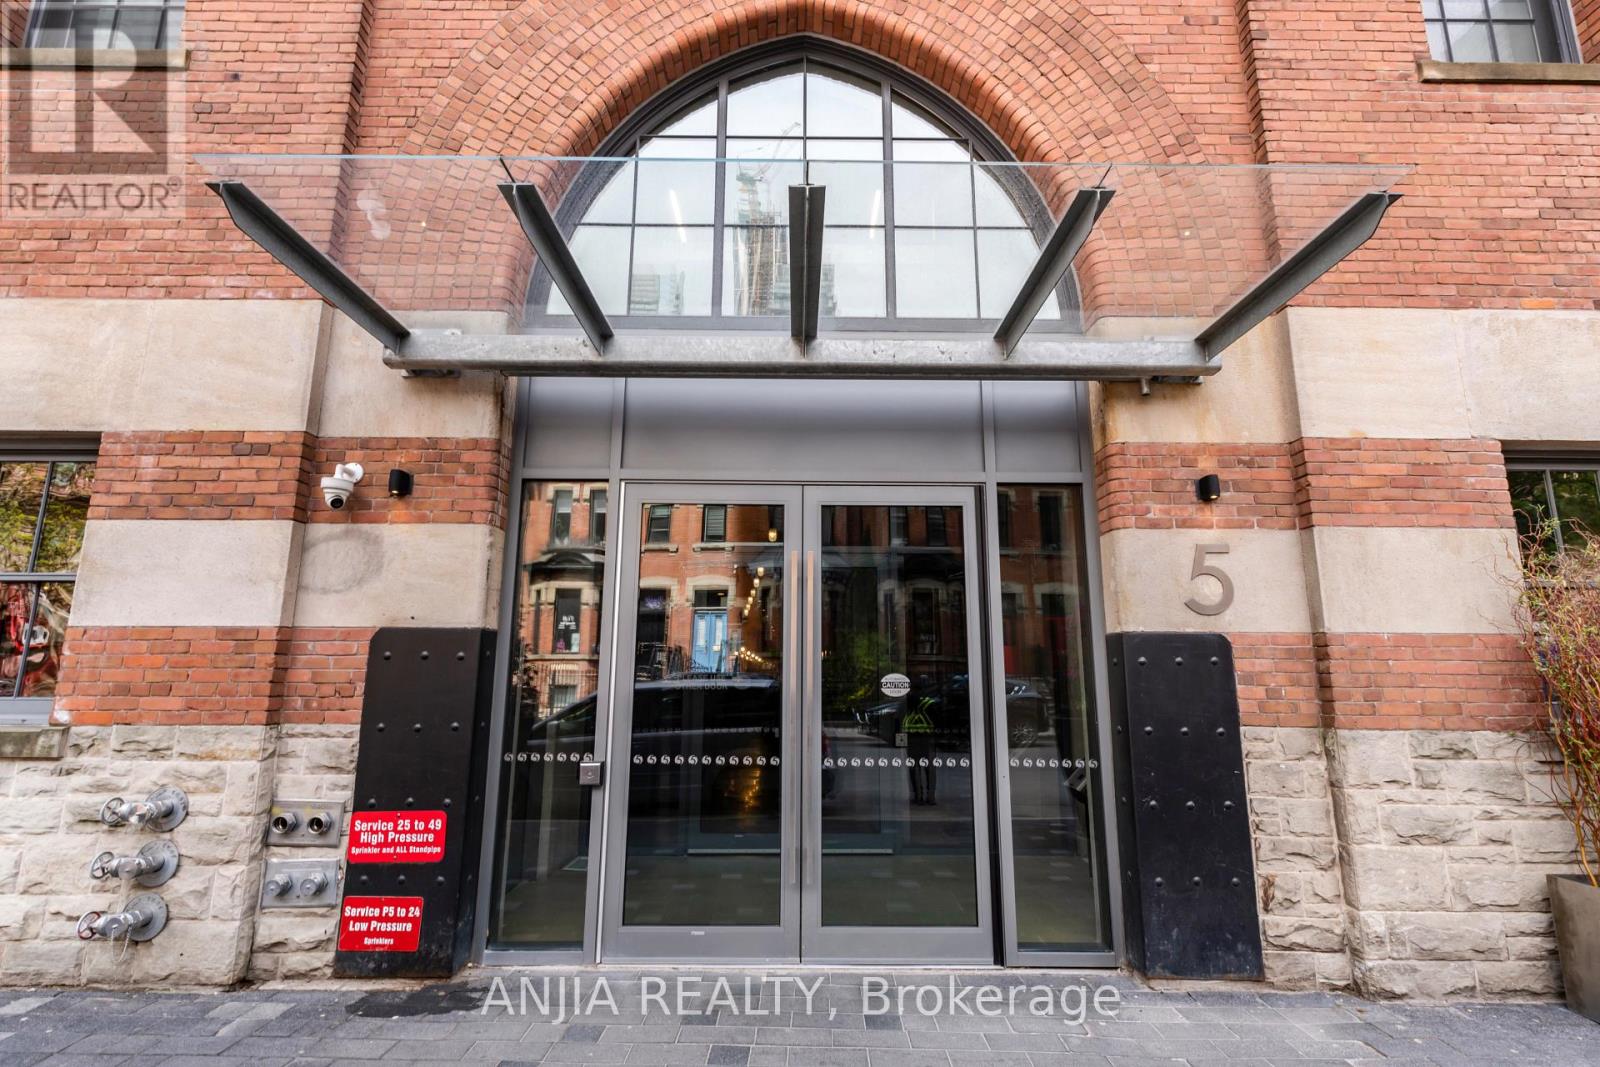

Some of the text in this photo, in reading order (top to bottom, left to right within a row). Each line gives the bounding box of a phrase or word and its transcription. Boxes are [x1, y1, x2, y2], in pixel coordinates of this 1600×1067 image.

[1184, 544, 1234, 616] 5
[354, 818, 442, 831] Service 25 to 49
[360, 831, 435, 845] High Pressure
[351, 846, 381, 855] Sprinkler
[409, 845, 442, 854] Standpipe
[344, 906, 421, 917] Service P5 to 24
[349, 920, 413, 932] Low Pressure
